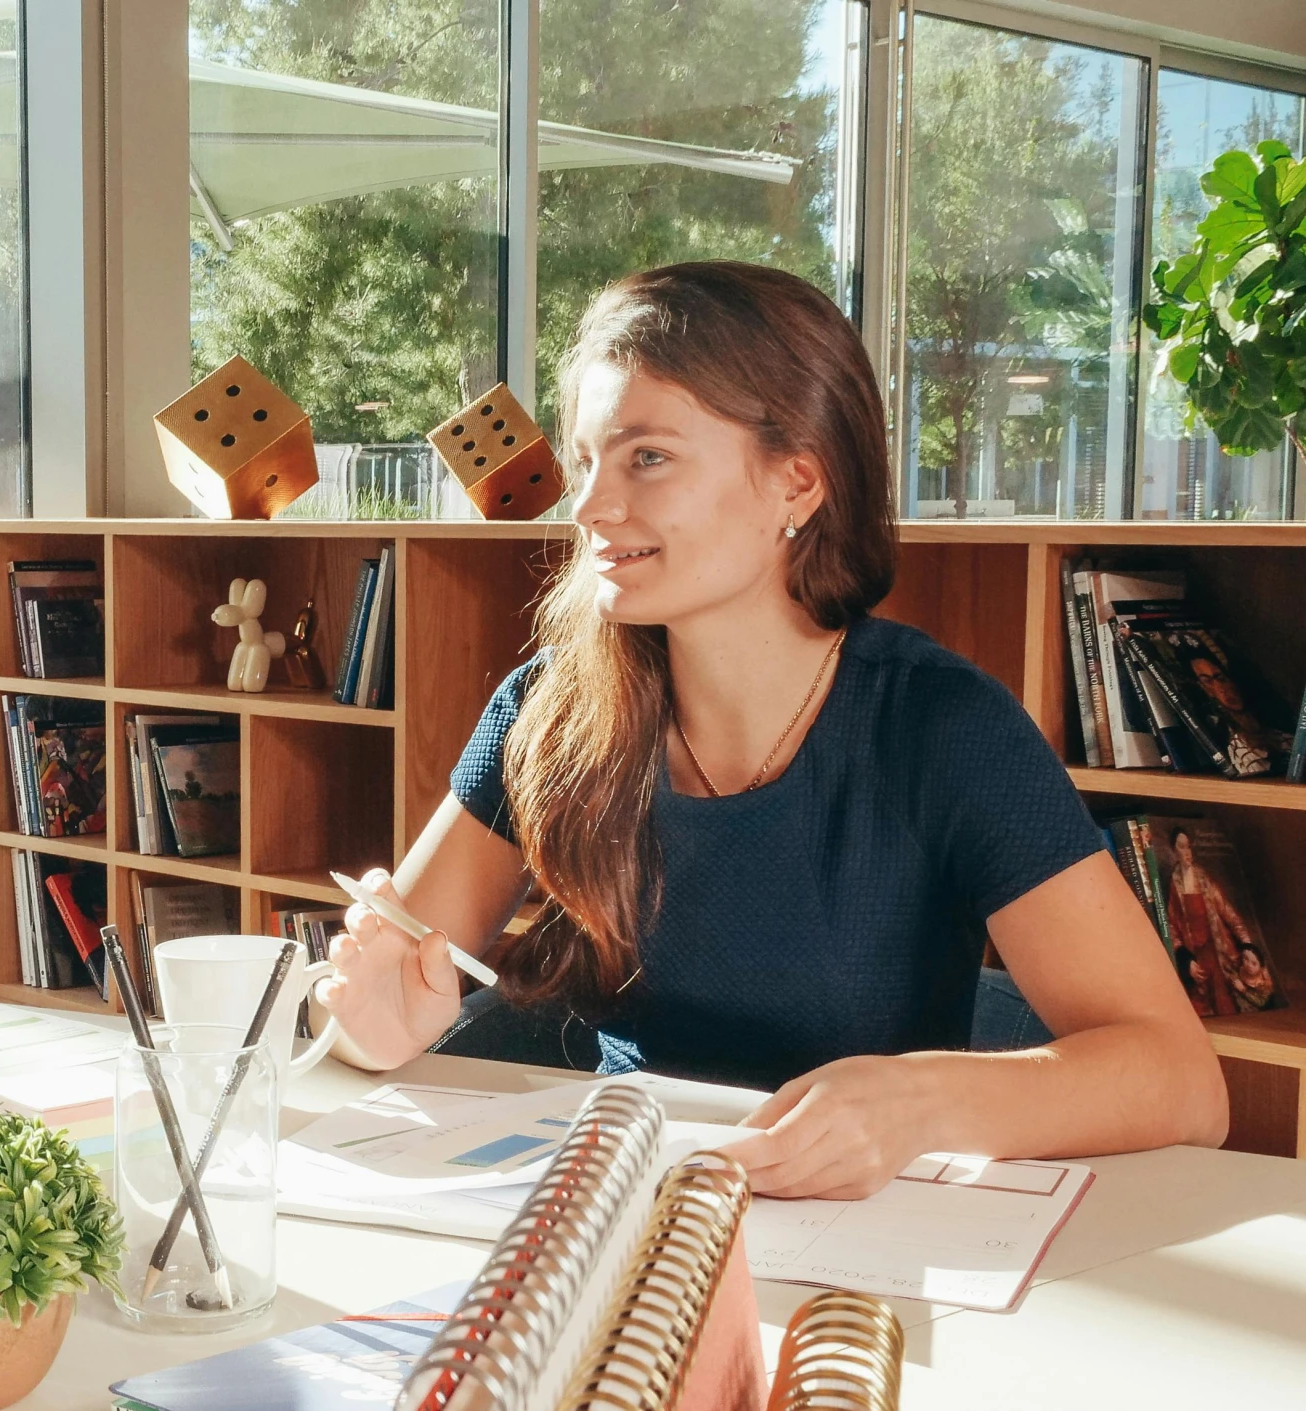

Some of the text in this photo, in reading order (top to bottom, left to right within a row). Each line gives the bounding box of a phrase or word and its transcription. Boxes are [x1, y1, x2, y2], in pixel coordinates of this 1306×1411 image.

[343, 636, 353, 657] TAPES
[1080, 605, 1105, 724] THE BARNS OF THE NORTH FORK
[1123, 656, 1139, 688] Masterpieces
[1129, 638, 1140, 651] Frida
[1148, 663, 1169, 691] Masterpieces
[1170, 693, 1179, 704] Art
[1125, 846, 1137, 877] RICHARD
[196, 1119, 217, 1150] WORK
[799, 1218, 826, 1227] 31
[985, 1238, 1019, 1249] 30
[811, 1265, 877, 1282] 2020
